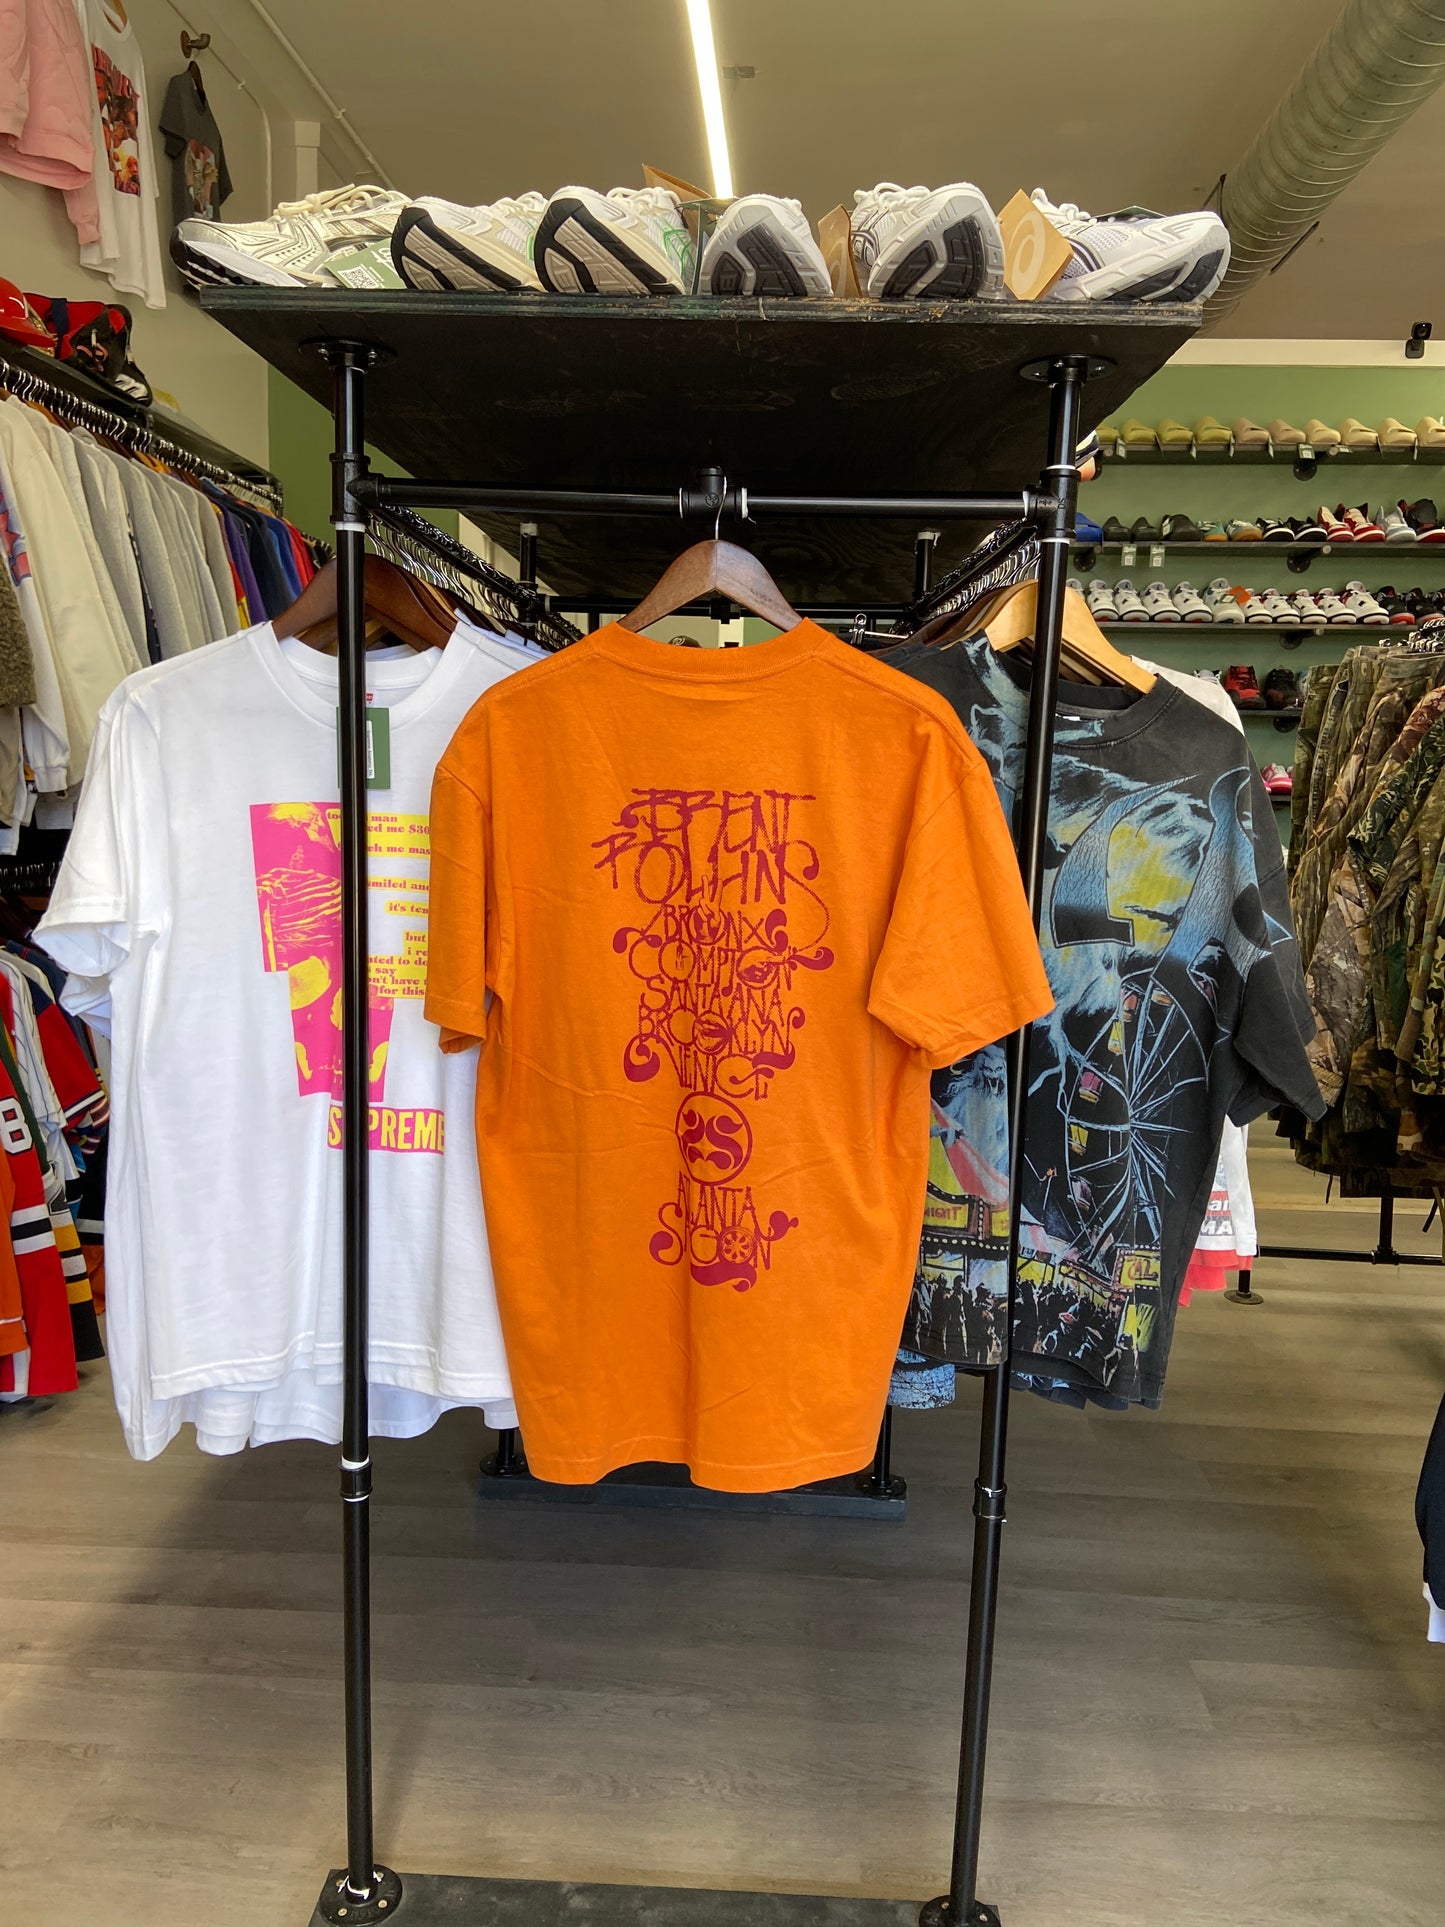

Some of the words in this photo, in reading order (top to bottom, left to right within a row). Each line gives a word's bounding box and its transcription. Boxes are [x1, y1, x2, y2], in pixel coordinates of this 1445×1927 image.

[371, 815, 398, 823] man
[389, 903, 407, 912] it's
[664, 903, 768, 948] BRONX
[405, 932, 426, 942] but
[398, 957, 410, 965] to
[625, 937, 800, 990] COMPTON
[375, 967, 396, 976] say
[391, 976, 420, 985] have
[379, 986, 398, 994] for
[402, 987, 425, 996] this
[637, 1003, 800, 1056] BROOKLYN
[328, 1106, 445, 1151] SPREME
